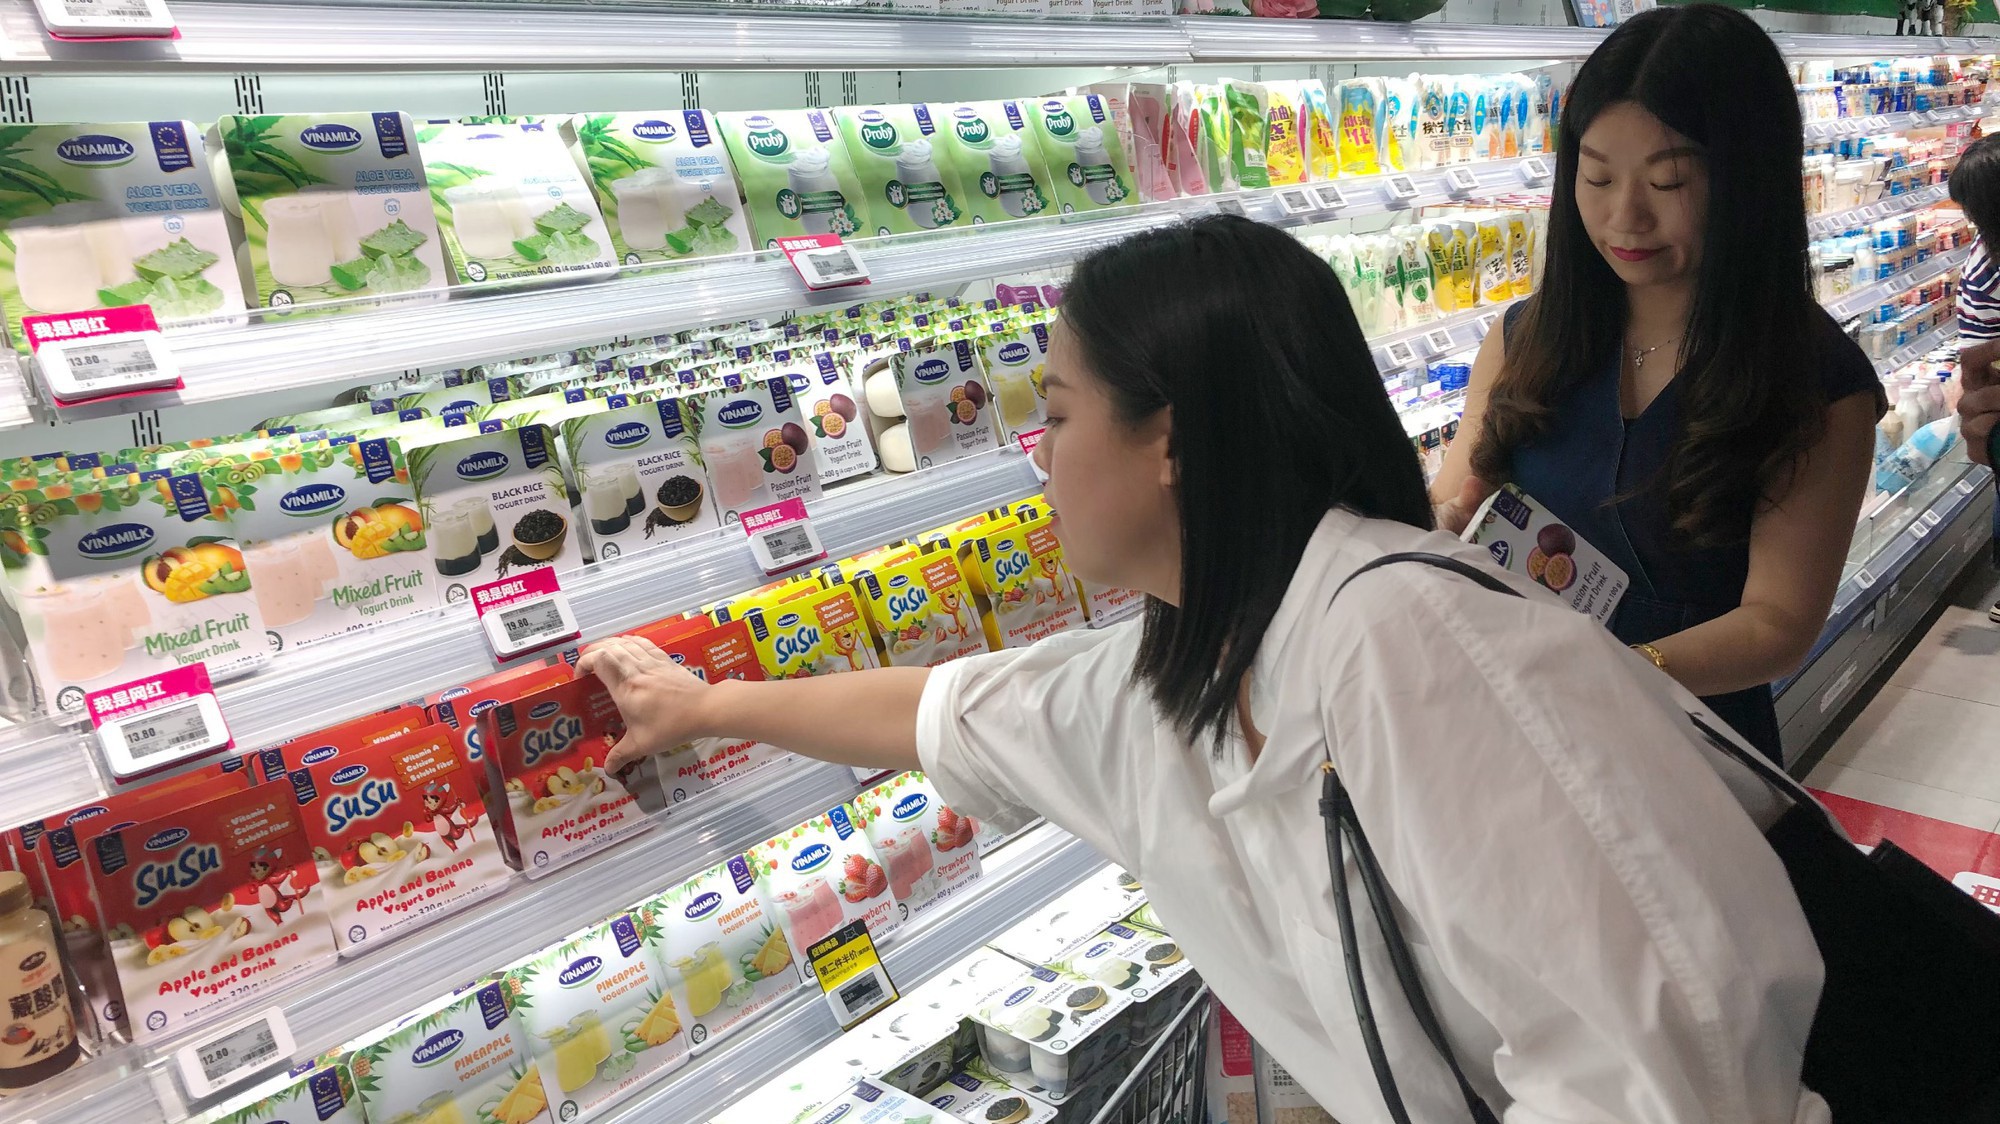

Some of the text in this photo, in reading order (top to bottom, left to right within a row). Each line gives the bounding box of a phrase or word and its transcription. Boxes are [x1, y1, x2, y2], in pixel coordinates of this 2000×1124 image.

[635, 125, 675, 135] VINAMILK
[958, 121, 985, 137] Proby
[1046, 115, 1071, 129] Proby
[304, 130, 359, 143] VINAMILK
[750, 131, 783, 149] Proby
[864, 127, 893, 141] Proby
[60, 142, 131, 157] VINAMILK
[676, 156, 720, 166] ALOE VERA
[355, 168, 415, 182] ALOE VERA
[126, 183, 201, 198] ALOE VERA
[354, 183, 420, 195] YOGURT DRINK
[126, 197, 210, 213] YOGURT DRINK
[32, 316, 110, 339] 我是网红
[1000, 345, 1030, 359] VINAMILK
[916, 362, 949, 378] VINAMILK
[720, 403, 761, 420] VINAMILK
[608, 425, 648, 442] VINAMILK
[956, 426, 989, 442] Passion Fruit
[823, 439, 863, 456] Passion Fruit
[829, 450, 863, 465] Yogurt Drink
[459, 455, 506, 475] VINAMILK
[637, 450, 682, 468] BLACK RICE
[639, 461, 685, 477] YOGURT DRINK
[491, 481, 544, 501] BLACK RICE
[770, 473, 812, 493] Passion Fruit
[283, 487, 343, 508] VINAMILK
[493, 493, 547, 512] YOGURT DRINK
[776, 486, 811, 501] Yogurt Drink
[744, 508, 783, 528] 我是网红
[82, 527, 152, 551] VINAMILK
[995, 551, 1031, 583] SuSu
[333, 569, 423, 606] Mixed Fruit
[476, 580, 527, 605] 我是网红
[1592, 574, 1608, 594] Drink
[357, 593, 414, 617] Yogurt Drink
[888, 586, 928, 622] SuSu
[1599, 601, 1611, 617] cups
[1610, 588, 1618, 599] 100
[506, 618, 529, 632] 19.80
[778, 614, 799, 626] VINAMILK
[1008, 616, 1046, 638] Strawberry
[1055, 605, 1077, 620] Banana
[144, 612, 250, 655] Mixed Fruit
[1025, 619, 1068, 642] Yogurt Drink
[174, 639, 241, 665] Yogurt Drink
[709, 637, 738, 654] Vitamin A
[712, 649, 734, 661] Calcium
[775, 626, 820, 665] SuSu
[714, 651, 748, 670] Soluble Fiber
[92, 680, 167, 713] 我是网红
[531, 704, 560, 717] VINAMILK
[127, 727, 156, 744] 13.80
[523, 716, 583, 765] SuSu
[303, 747, 338, 763] VINAMILK
[402, 744, 440, 763] Vitamin A
[406, 757, 435, 772] Calcium
[410, 759, 454, 781] Soluble Fiber
[698, 754, 750, 780] Yogurt Drink
[332, 767, 366, 783] VINAMILK
[231, 803, 276, 825] Vitamin A
[326, 780, 398, 834] SuSu
[542, 792, 640, 839] Apple and Banana
[894, 796, 926, 816] VINAMILK
[68, 808, 106, 826] VINAMILK
[233, 818, 268, 836] Calcium
[564, 811, 625, 842] Yogurt Drink
[148, 830, 186, 848] VINAMILK
[237, 820, 290, 846] Soluble Fiber
[792, 845, 832, 870] VINAMILK
[937, 850, 974, 878] Strawberry
[135, 845, 221, 908] SuSu
[356, 857, 474, 912] Apple and Banana
[937, 889, 947, 899] 400
[967, 873, 975, 881] 100
[383, 878, 457, 914] Yogurt Drink
[686, 893, 721, 917] VINAMILK
[717, 898, 760, 927] PINEAPPLE
[722, 910, 763, 937] YOGURT DRINK
[158, 931, 300, 997] Apple and Banana
[560, 957, 602, 983] VINAMILK
[189, 956, 278, 999] Yogurt Drink
[596, 961, 646, 993] PINEAPPLE
[601, 974, 650, 1004] YOGURT DRINK
[414, 1031, 463, 1061] VINAMILK
[454, 1033, 512, 1072] PINEAPPLE
[202, 1047, 229, 1066] 12.80
[458, 1048, 515, 1083] YOGURT DRINK
[975, 1092, 991, 1102] RICE
